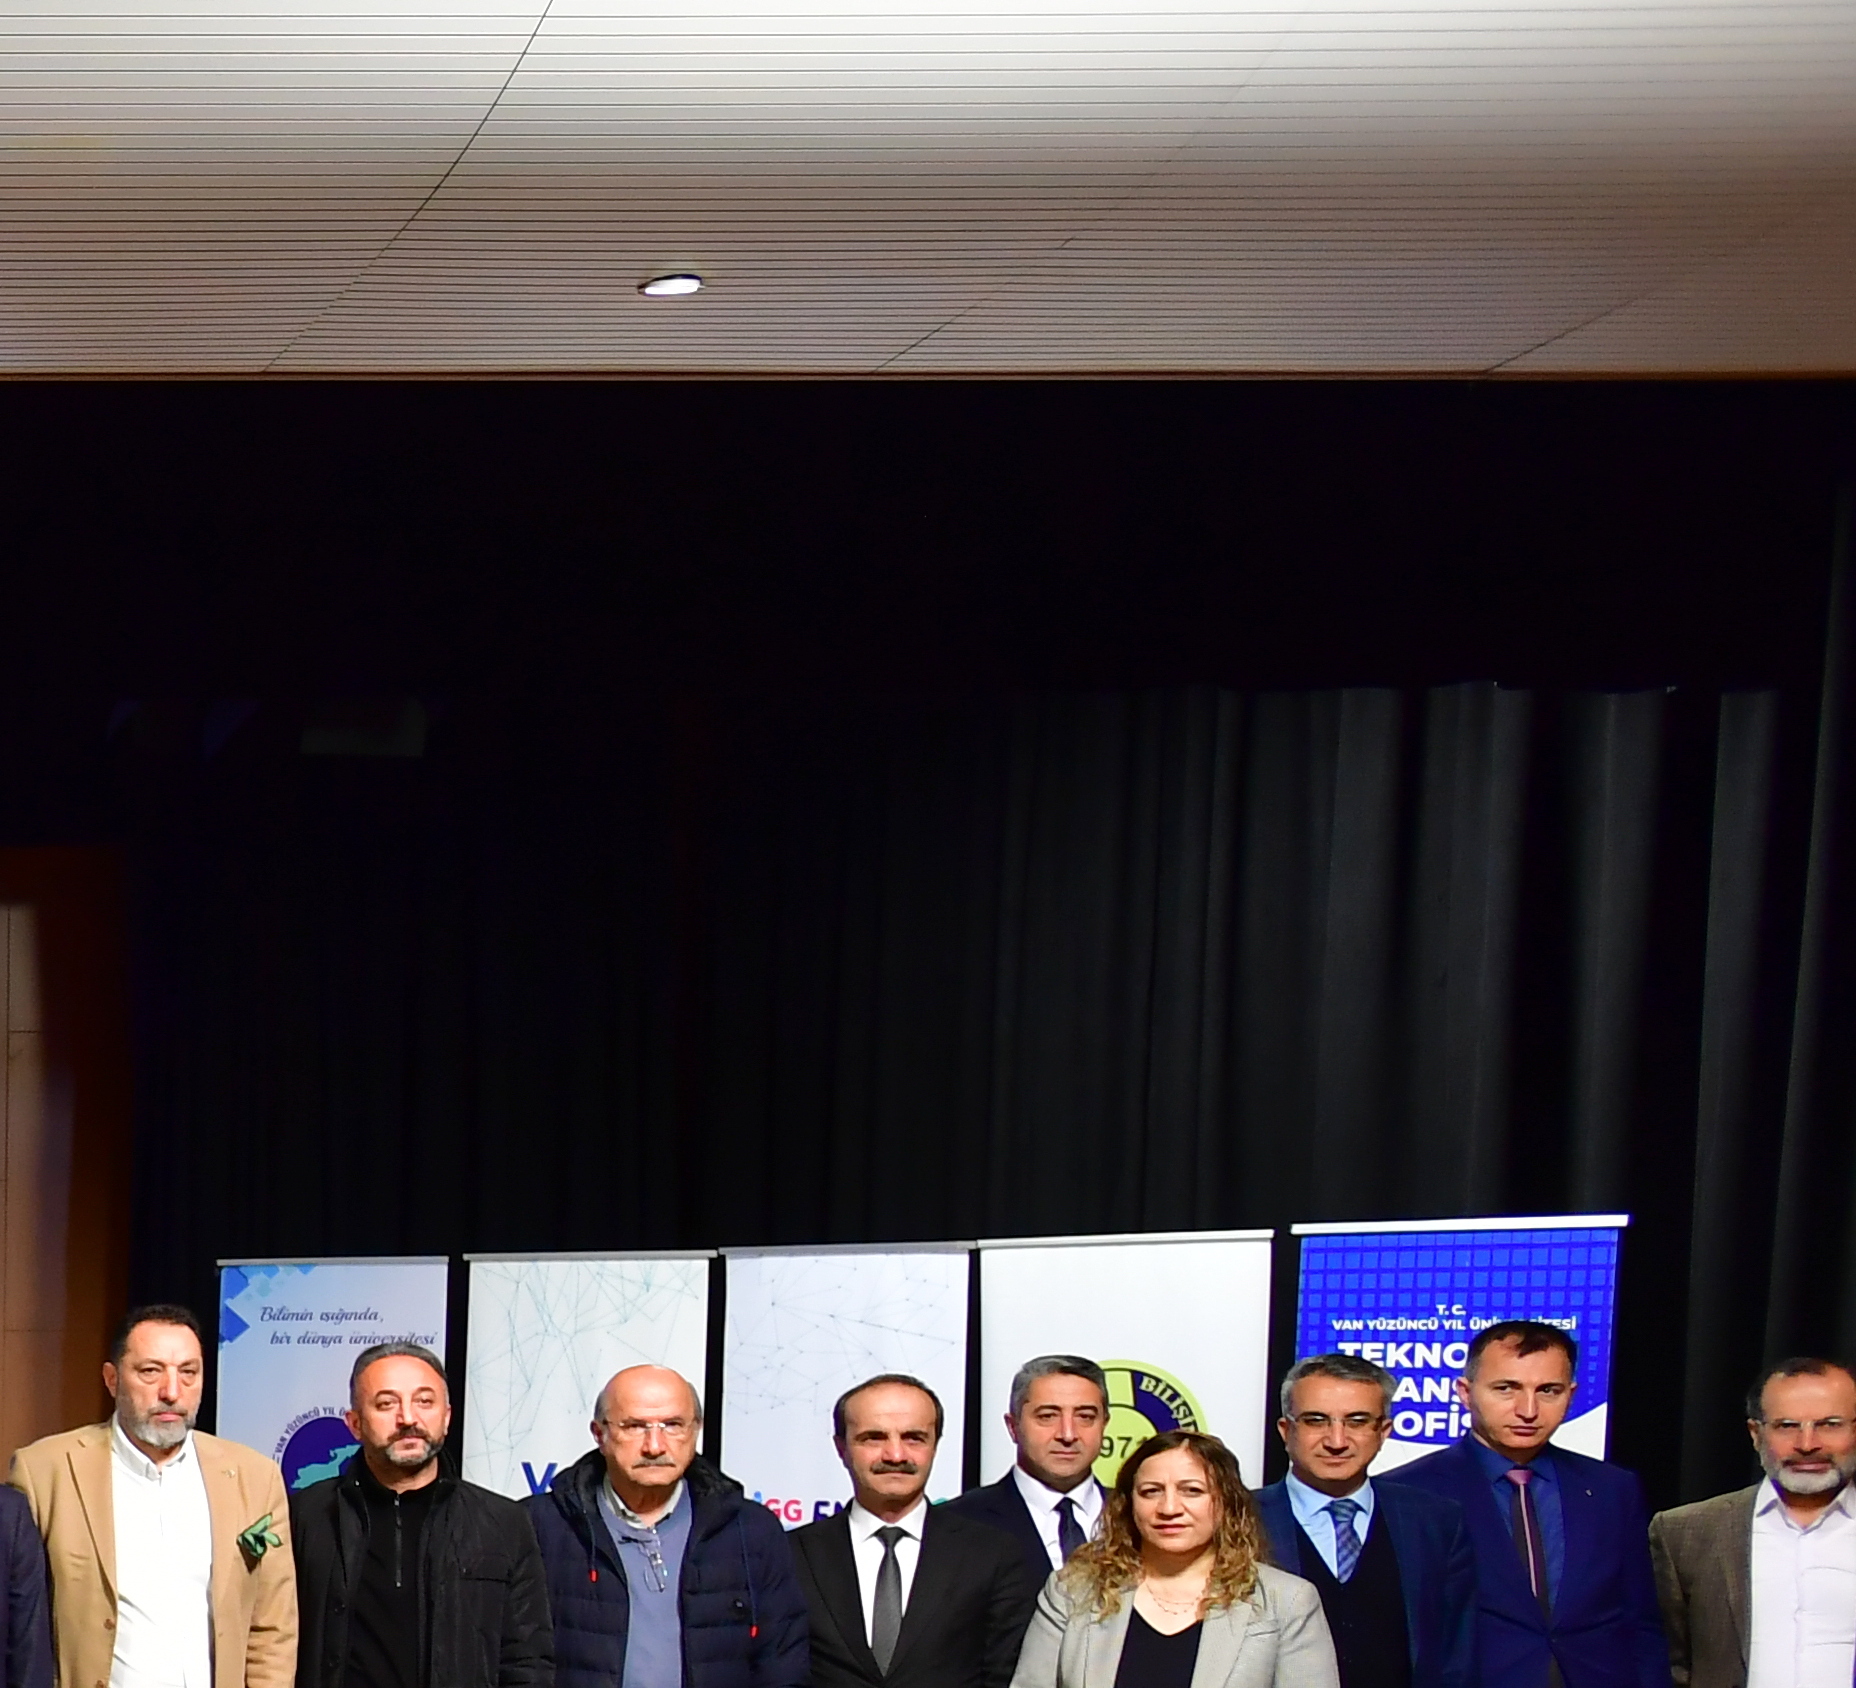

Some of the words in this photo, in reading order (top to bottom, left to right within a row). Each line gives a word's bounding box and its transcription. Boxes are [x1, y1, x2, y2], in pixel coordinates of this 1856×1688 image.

[260, 1306, 314, 1322] Bilimin
[1332, 1319, 1363, 1330] VAN
[1367, 1317, 1439, 1331] YÜZÜNCÜ
[1443, 1319, 1465, 1331] YIL
[1337, 1342, 1469, 1369] TEKNO
